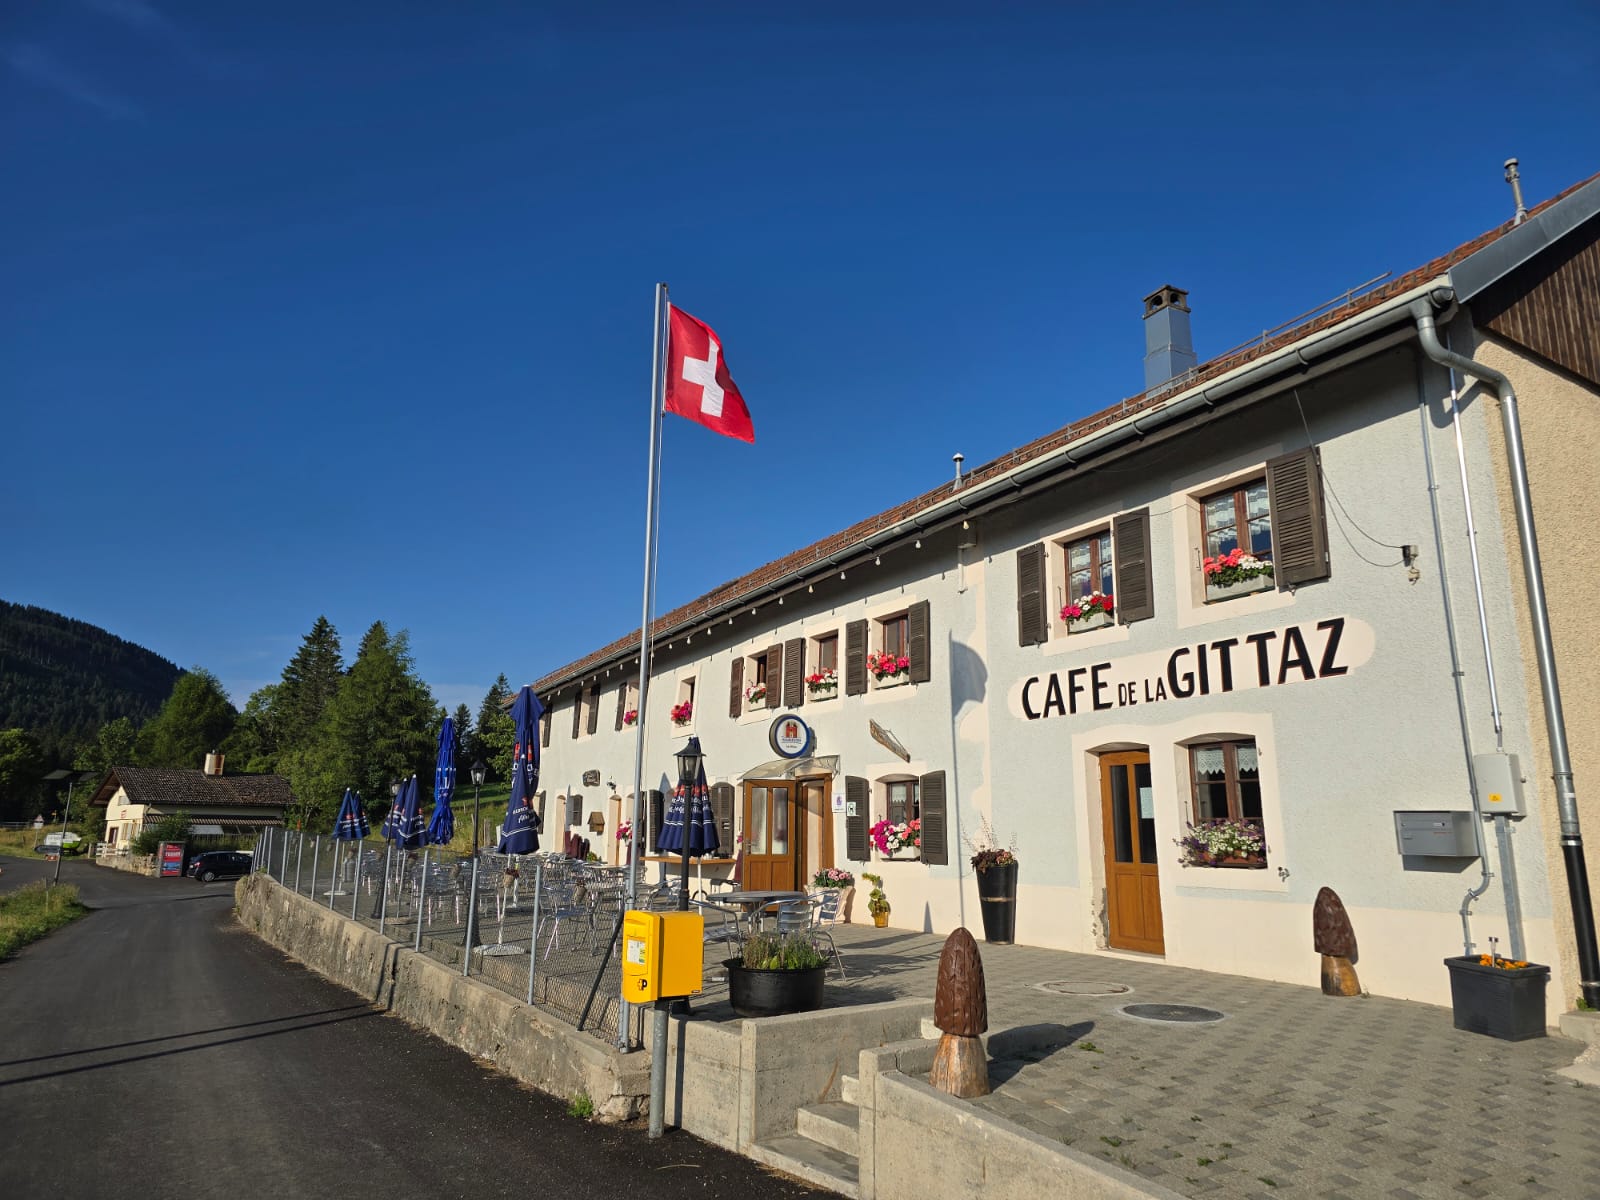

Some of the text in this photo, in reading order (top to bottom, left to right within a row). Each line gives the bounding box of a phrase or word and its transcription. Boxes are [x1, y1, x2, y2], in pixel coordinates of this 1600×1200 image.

[1022, 617, 1349, 720] CAFE DE LA GITTAZ
